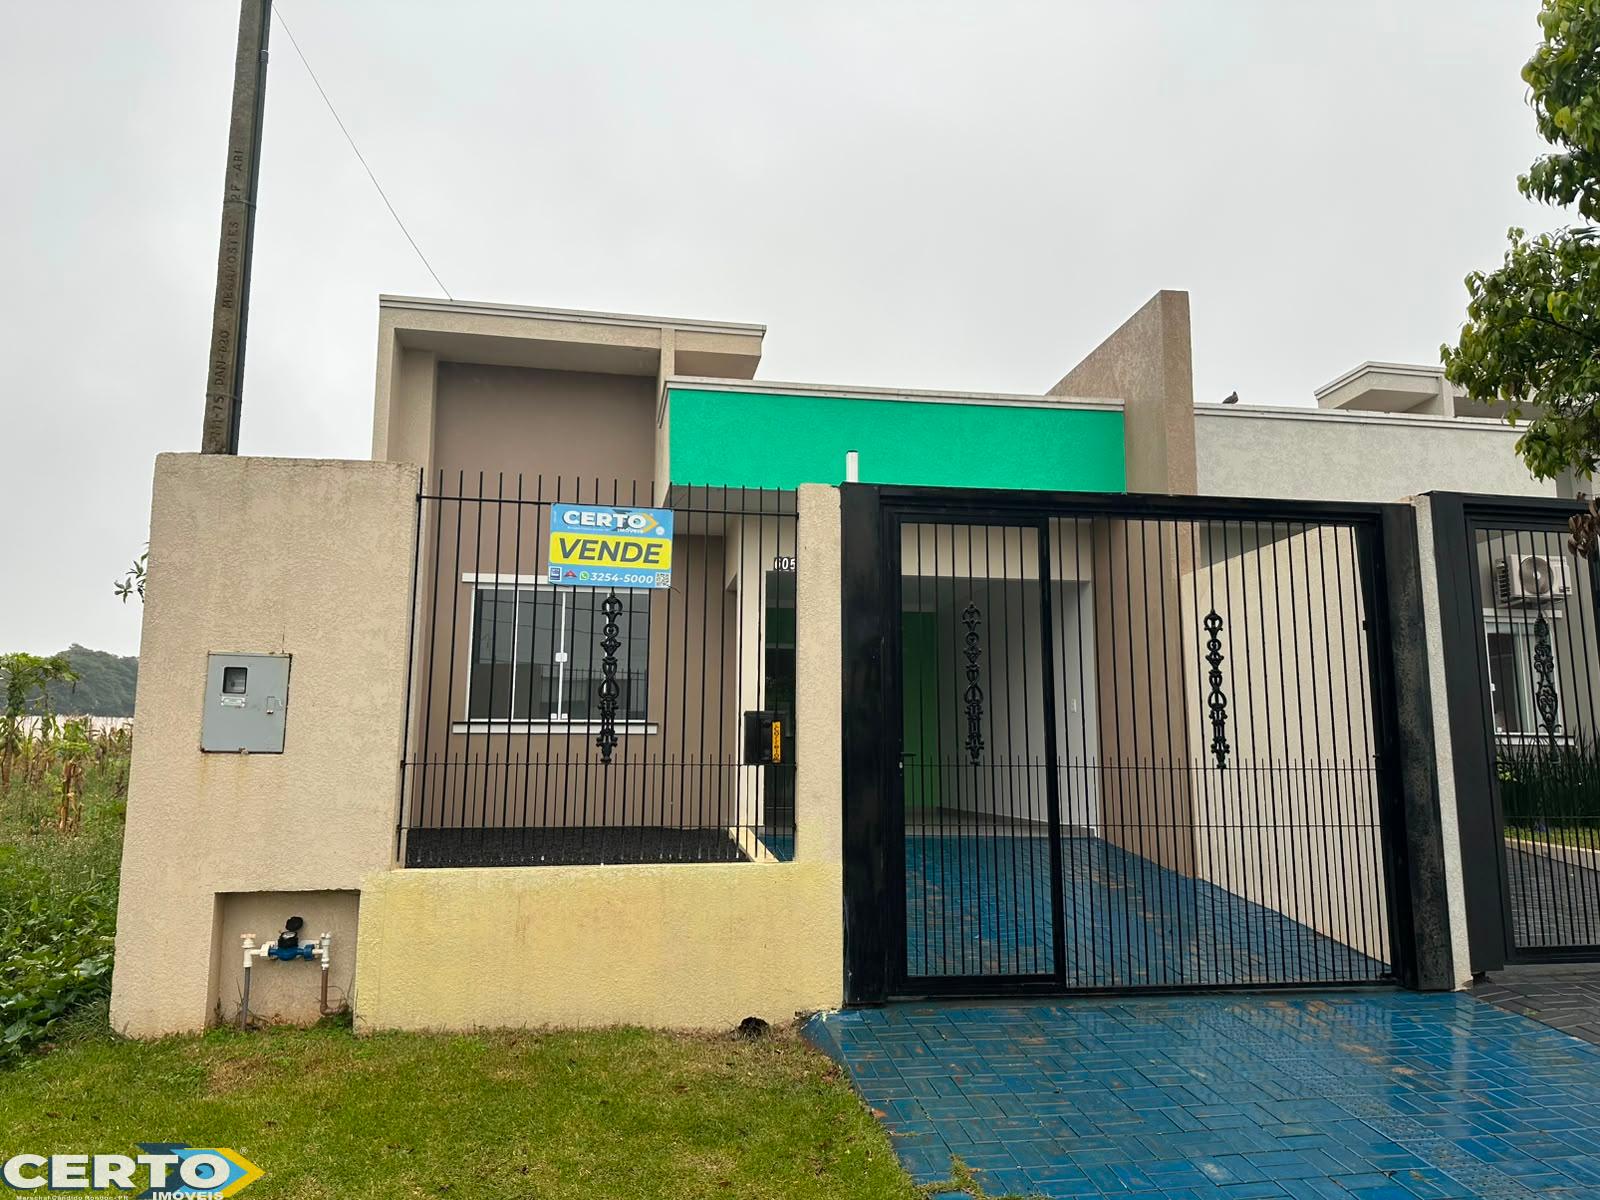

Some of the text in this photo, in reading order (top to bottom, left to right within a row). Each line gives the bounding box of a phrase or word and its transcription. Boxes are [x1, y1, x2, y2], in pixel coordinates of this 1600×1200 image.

[563, 510, 647, 529] CERTO
[559, 538, 663, 564] VENDE
[590, 572, 654, 584] 3254-5000
